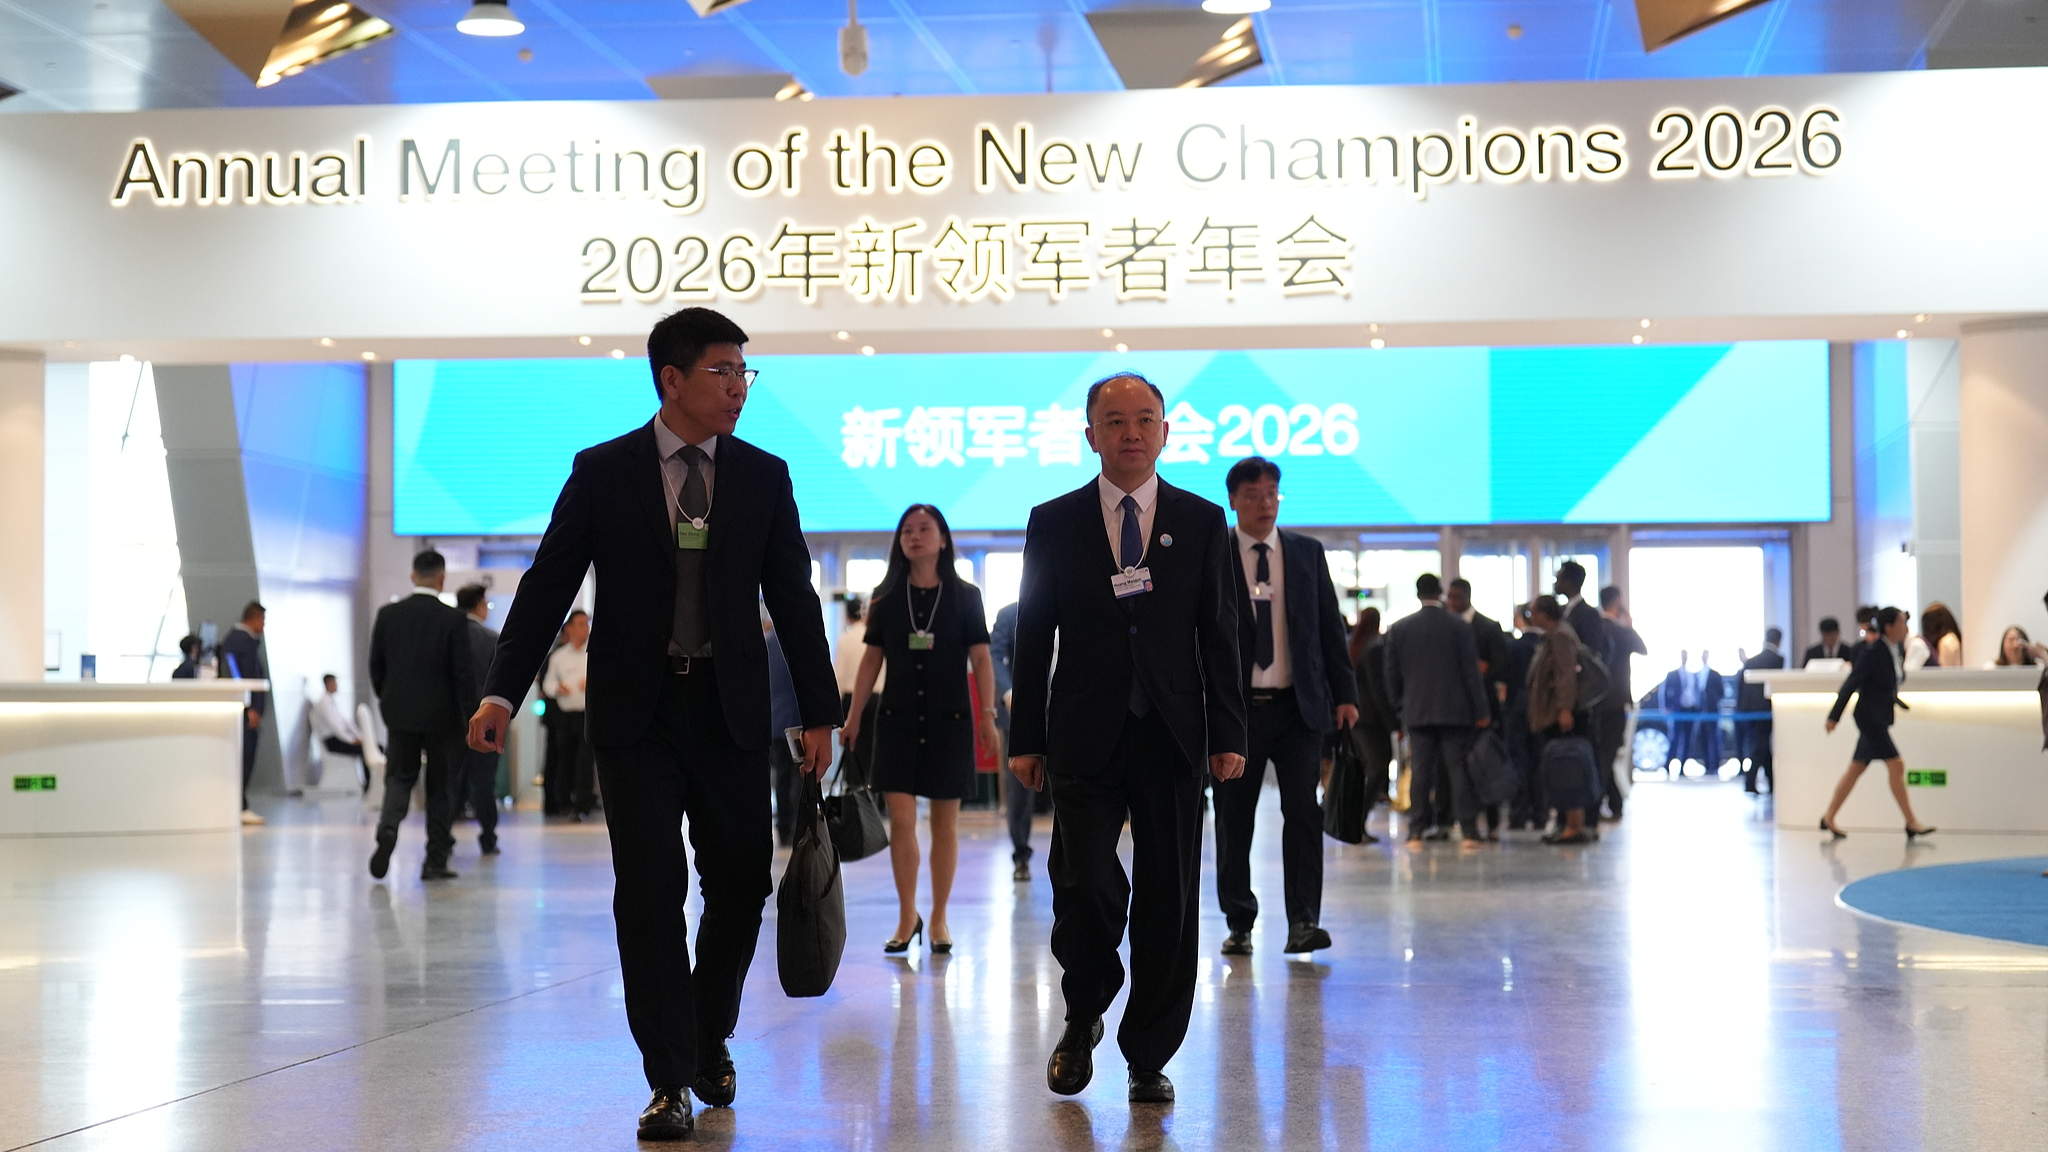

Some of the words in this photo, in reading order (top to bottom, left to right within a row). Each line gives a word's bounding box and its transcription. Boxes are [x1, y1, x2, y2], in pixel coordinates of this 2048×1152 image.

[113, 138, 366, 202] Annual
[400, 137, 700, 210] Meeting
[732, 129, 801, 191] of
[832, 130, 947, 190] the
[981, 125, 1144, 187] New
[1175, 117, 1624, 194] Champions
[1656, 109, 1843, 173] 2026
[580, 214, 1350, 298] 2026年新领军者年会
[841, 401, 1360, 468] 新领军者会2026
